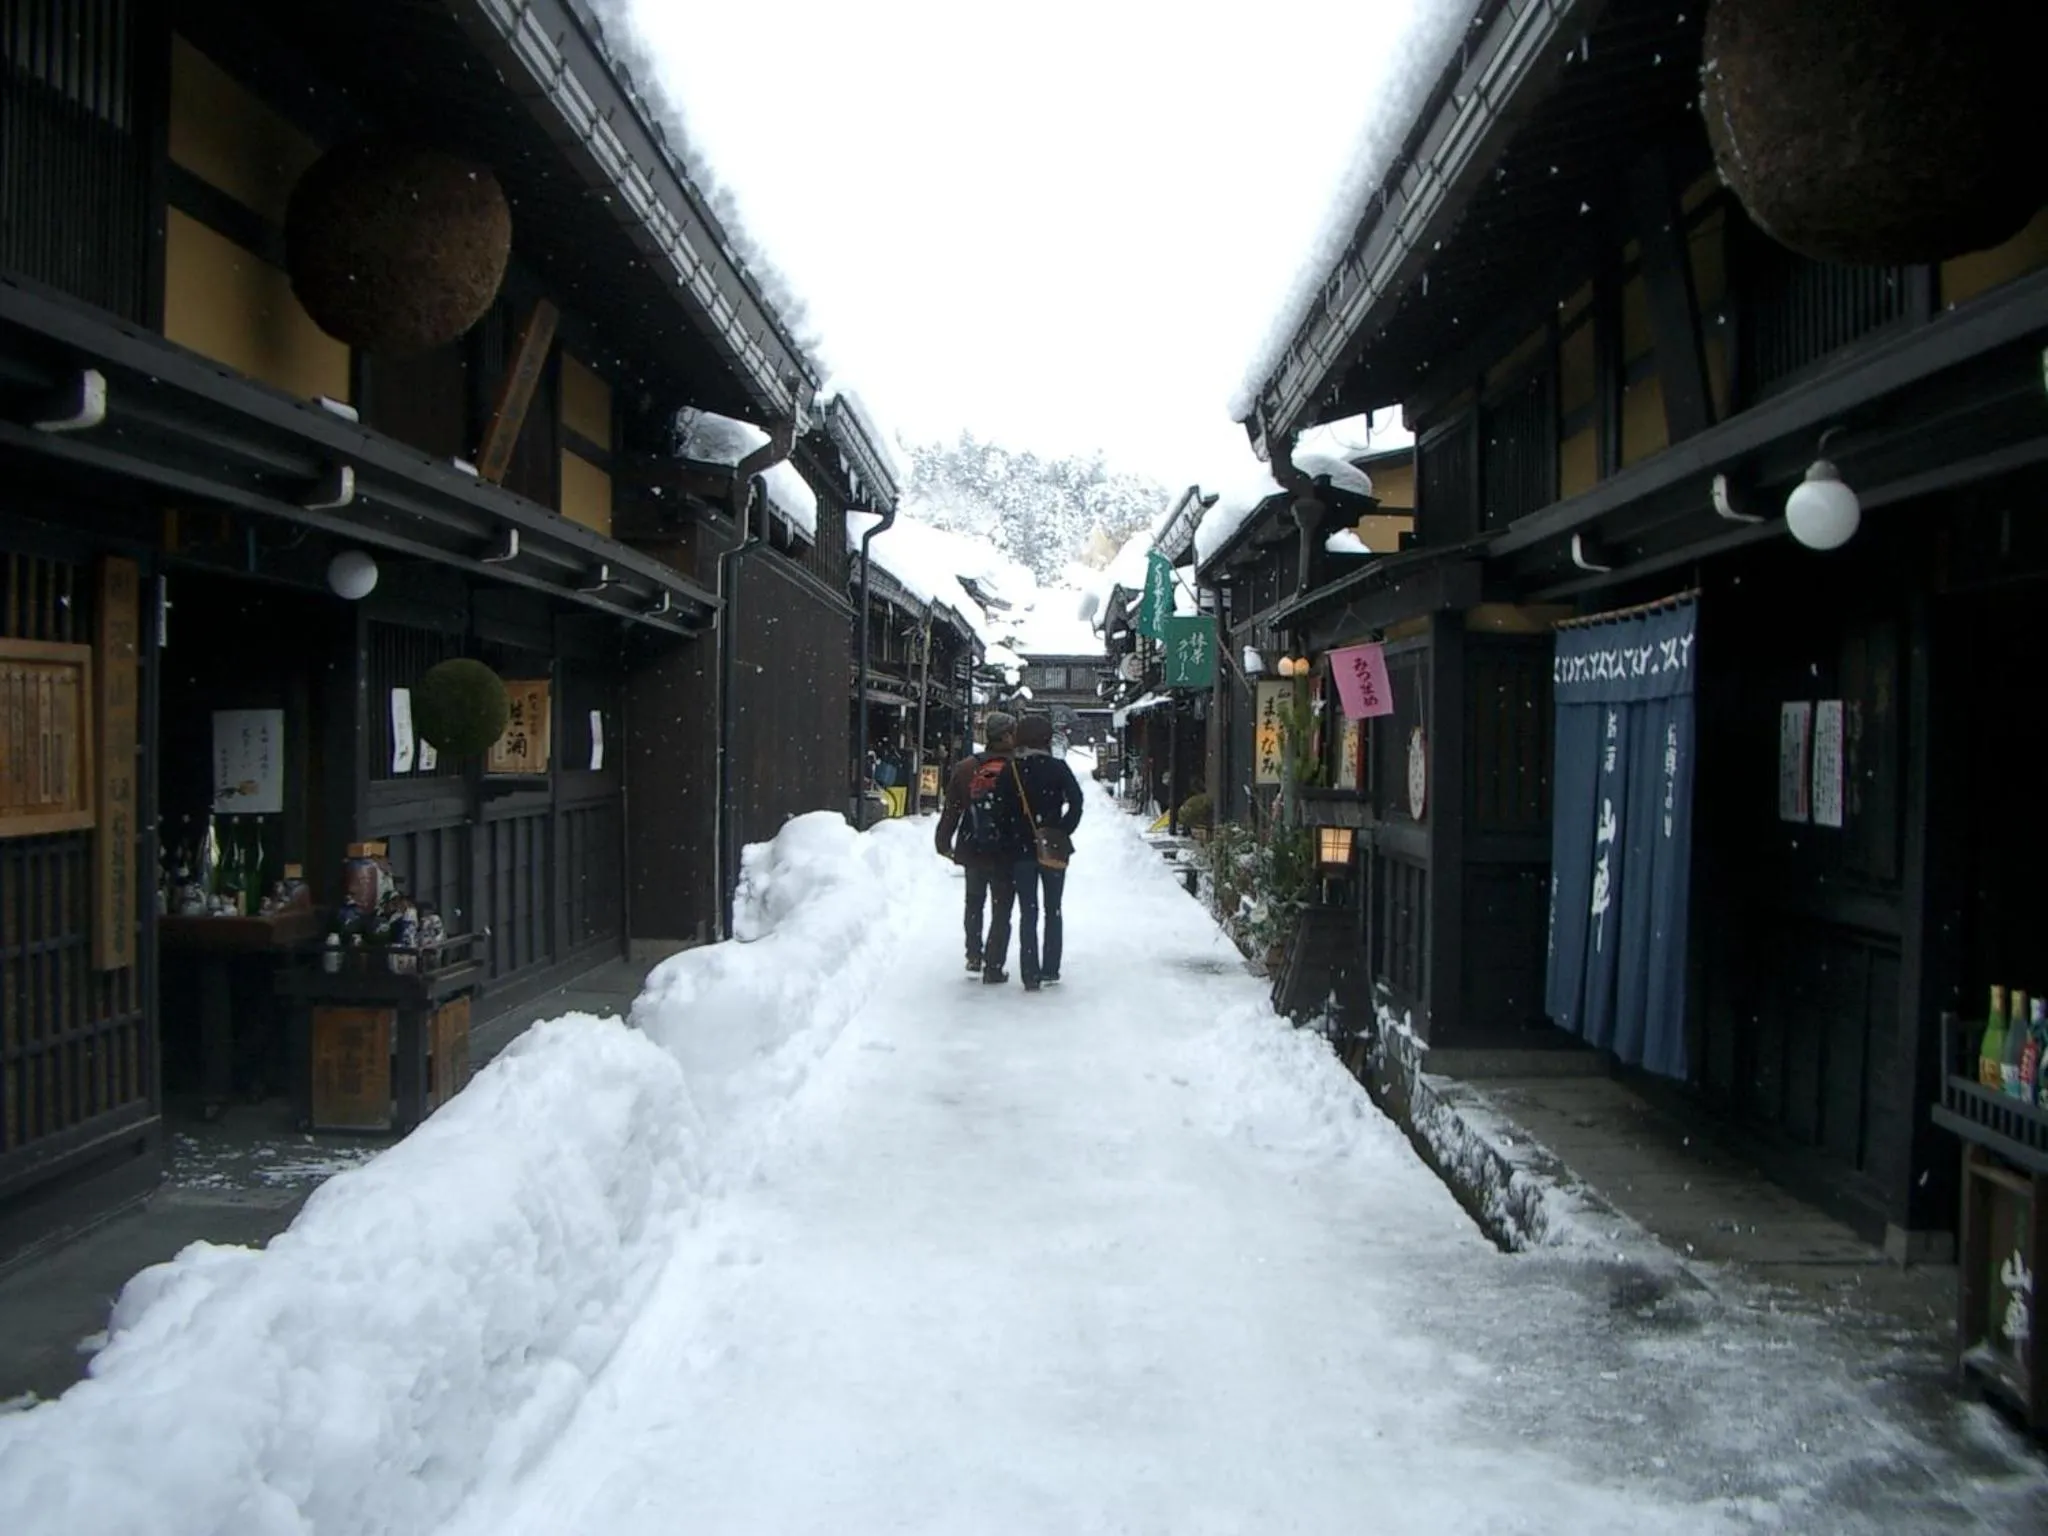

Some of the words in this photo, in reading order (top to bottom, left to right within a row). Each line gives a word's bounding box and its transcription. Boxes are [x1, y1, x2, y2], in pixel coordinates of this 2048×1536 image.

[1176, 639, 1189, 682] クリーム
[1190, 631, 1208, 666] 抹茶
[1352, 656, 1380, 707] みつまめ
[1260, 696, 1276, 775] まちなみ
